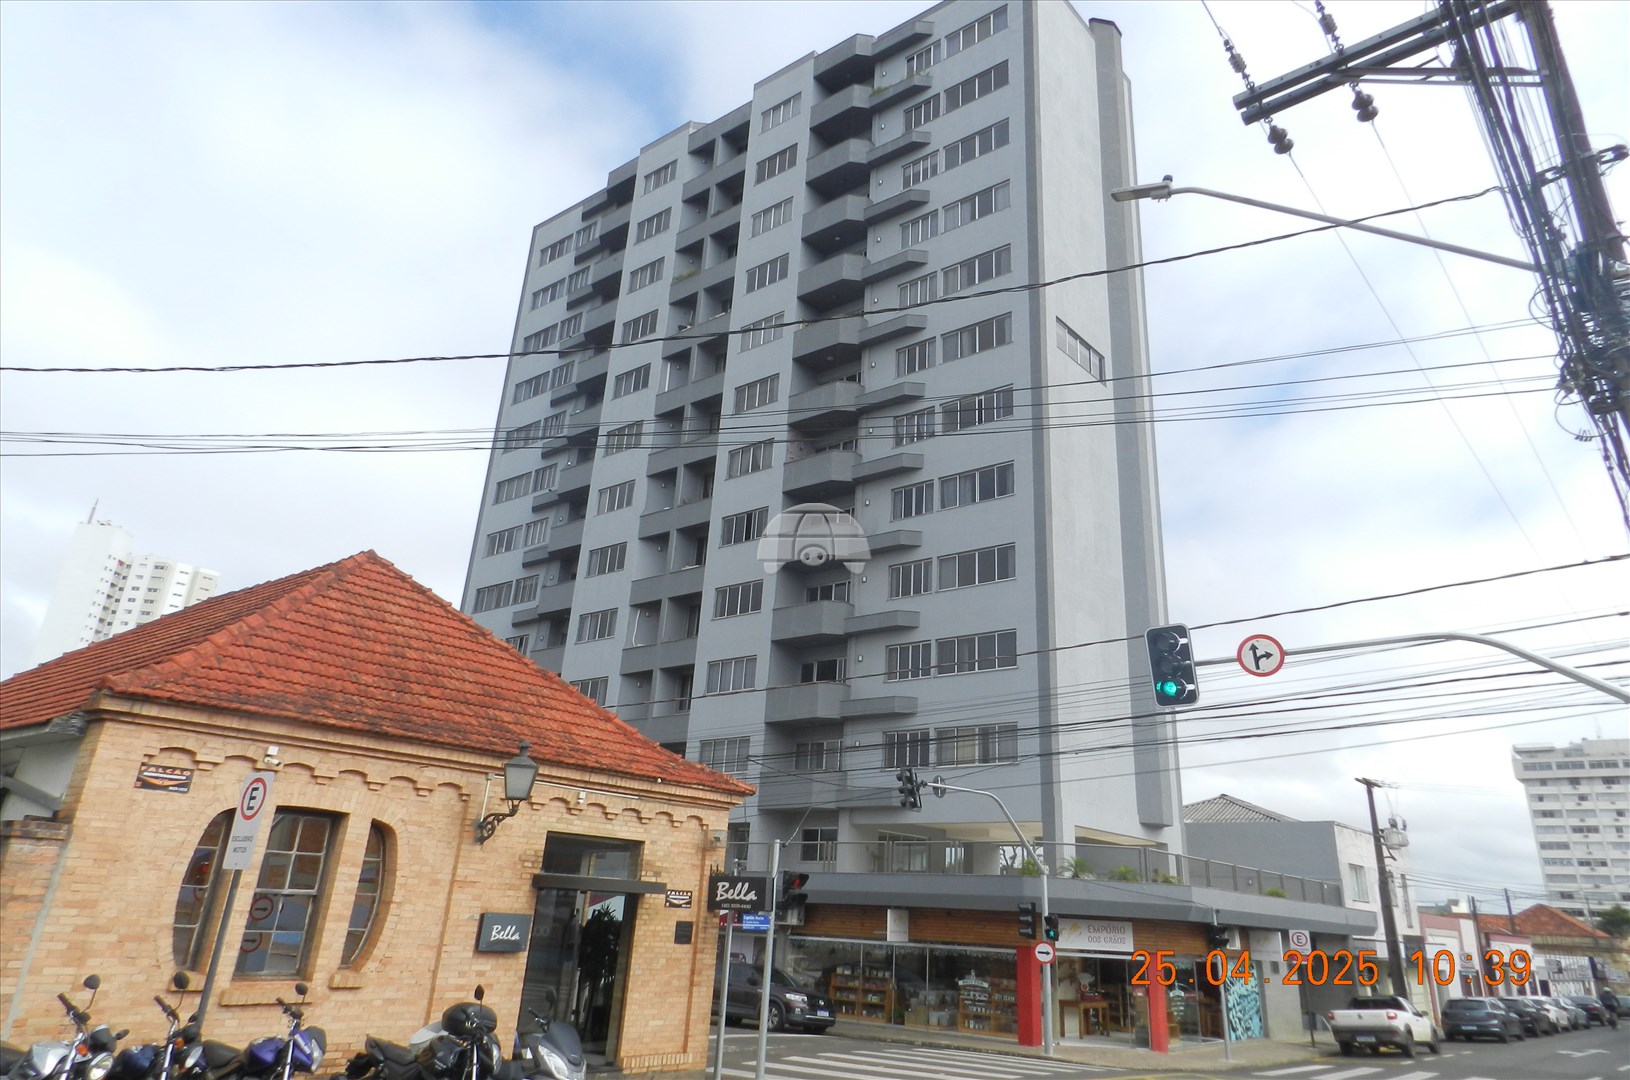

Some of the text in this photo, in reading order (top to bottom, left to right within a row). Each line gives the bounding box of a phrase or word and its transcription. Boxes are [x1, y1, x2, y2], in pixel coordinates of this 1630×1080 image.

[246, 786, 260, 811] E
[715, 881, 758, 901] Bella
[490, 924, 521, 941] Bella
[1087, 923, 1126, 935] EMPÓRIO
[1087, 935, 1102, 944] DOS
[1296, 934, 1303, 944] E
